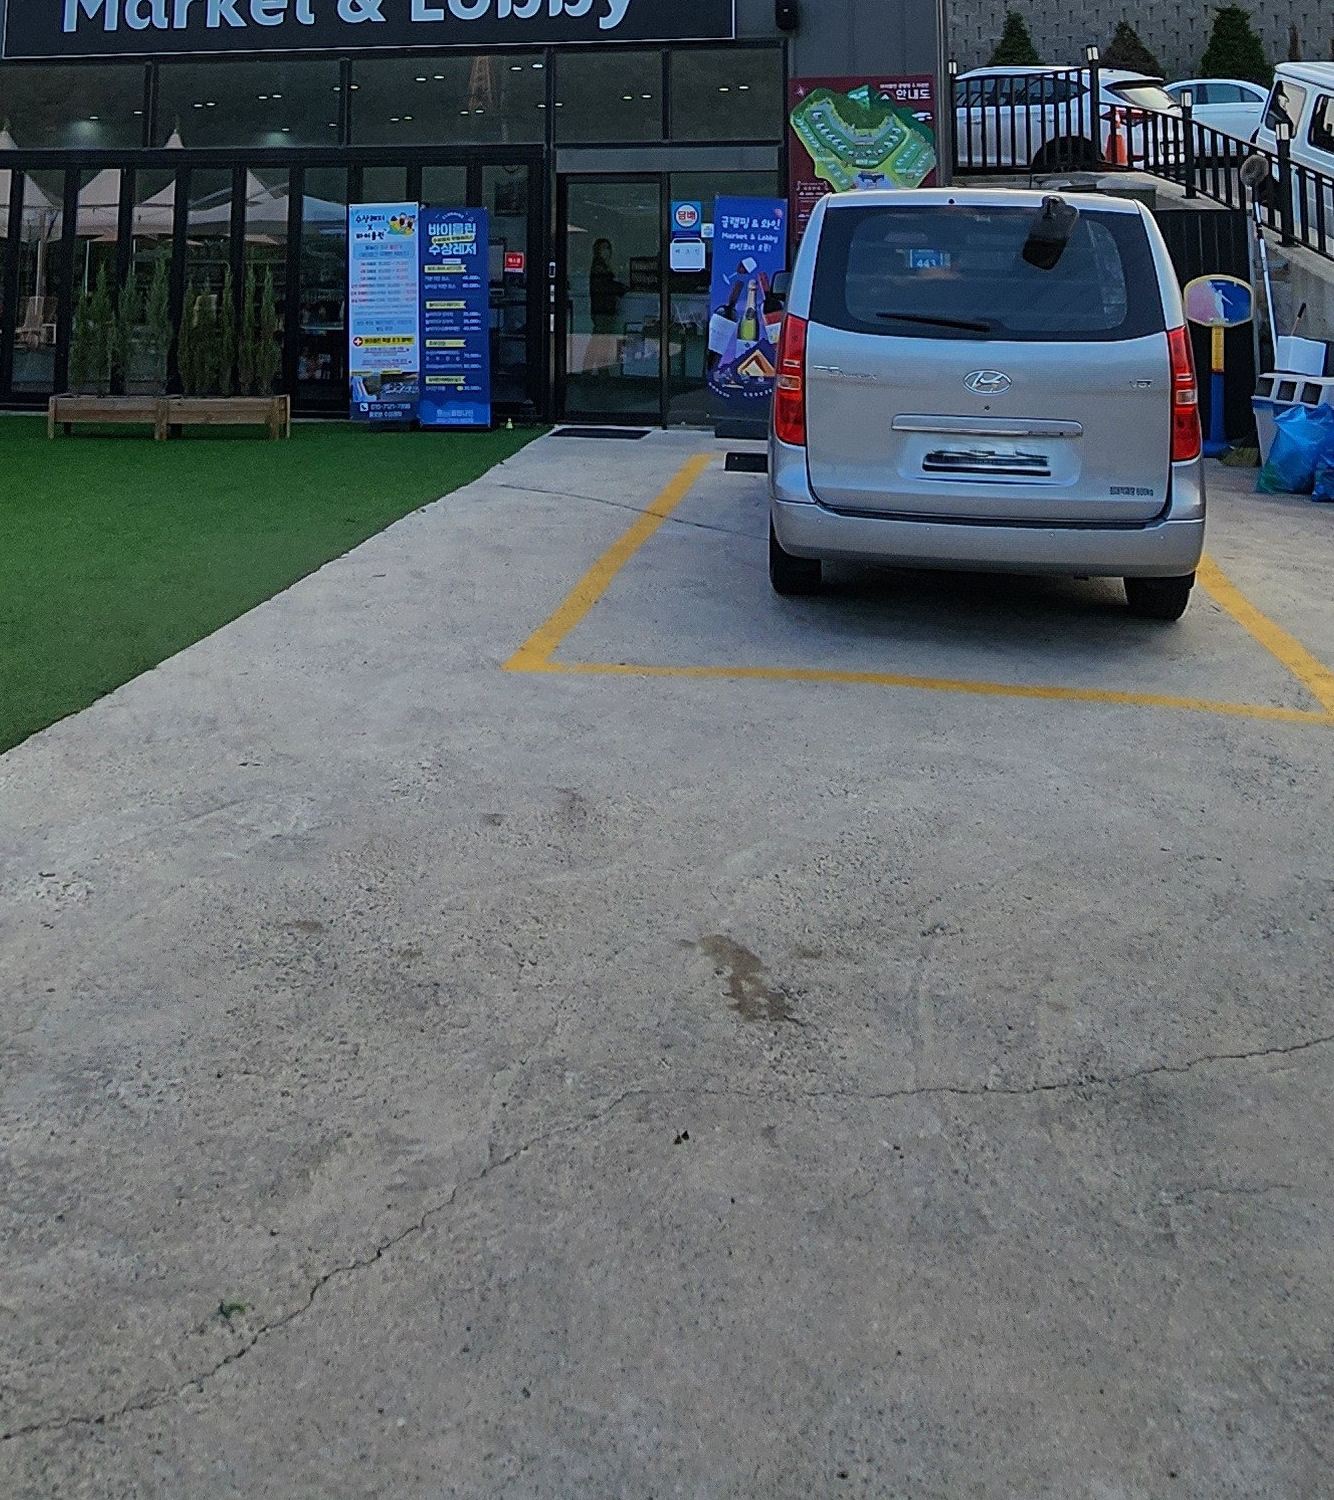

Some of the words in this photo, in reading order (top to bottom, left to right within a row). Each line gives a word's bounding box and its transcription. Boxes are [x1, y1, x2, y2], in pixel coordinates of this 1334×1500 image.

[896, 89, 931, 101] 안내도
[677, 210, 696, 220] 담배
[720, 215, 750, 230] 글램핑
[760, 218, 781, 230] 와인
[721, 232, 748, 240] Market
[757, 234, 779, 244] Lobby
[428, 243, 477, 256] 수상레저
